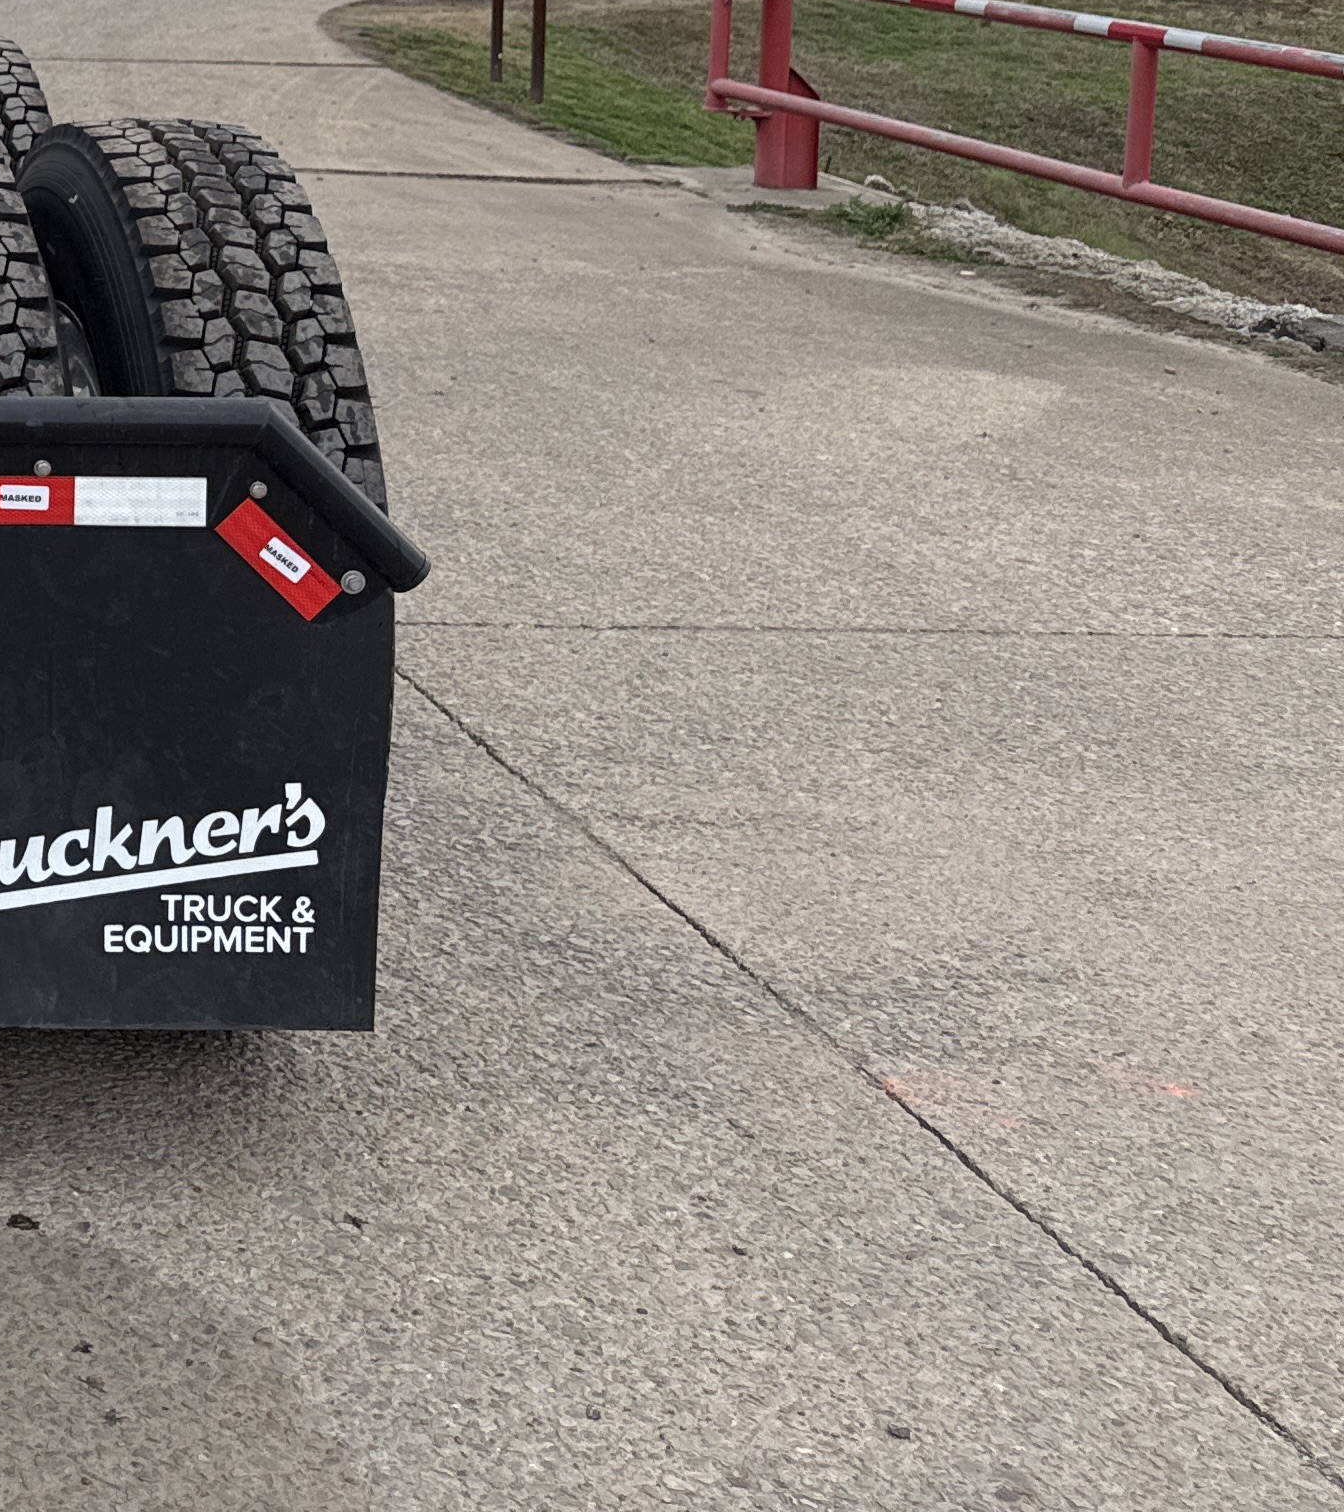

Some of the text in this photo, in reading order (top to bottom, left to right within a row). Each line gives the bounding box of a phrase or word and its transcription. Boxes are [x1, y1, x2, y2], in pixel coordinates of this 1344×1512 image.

[161, 894, 316, 924] TRUCK &
[103, 924, 315, 954] EQUIPMENT
